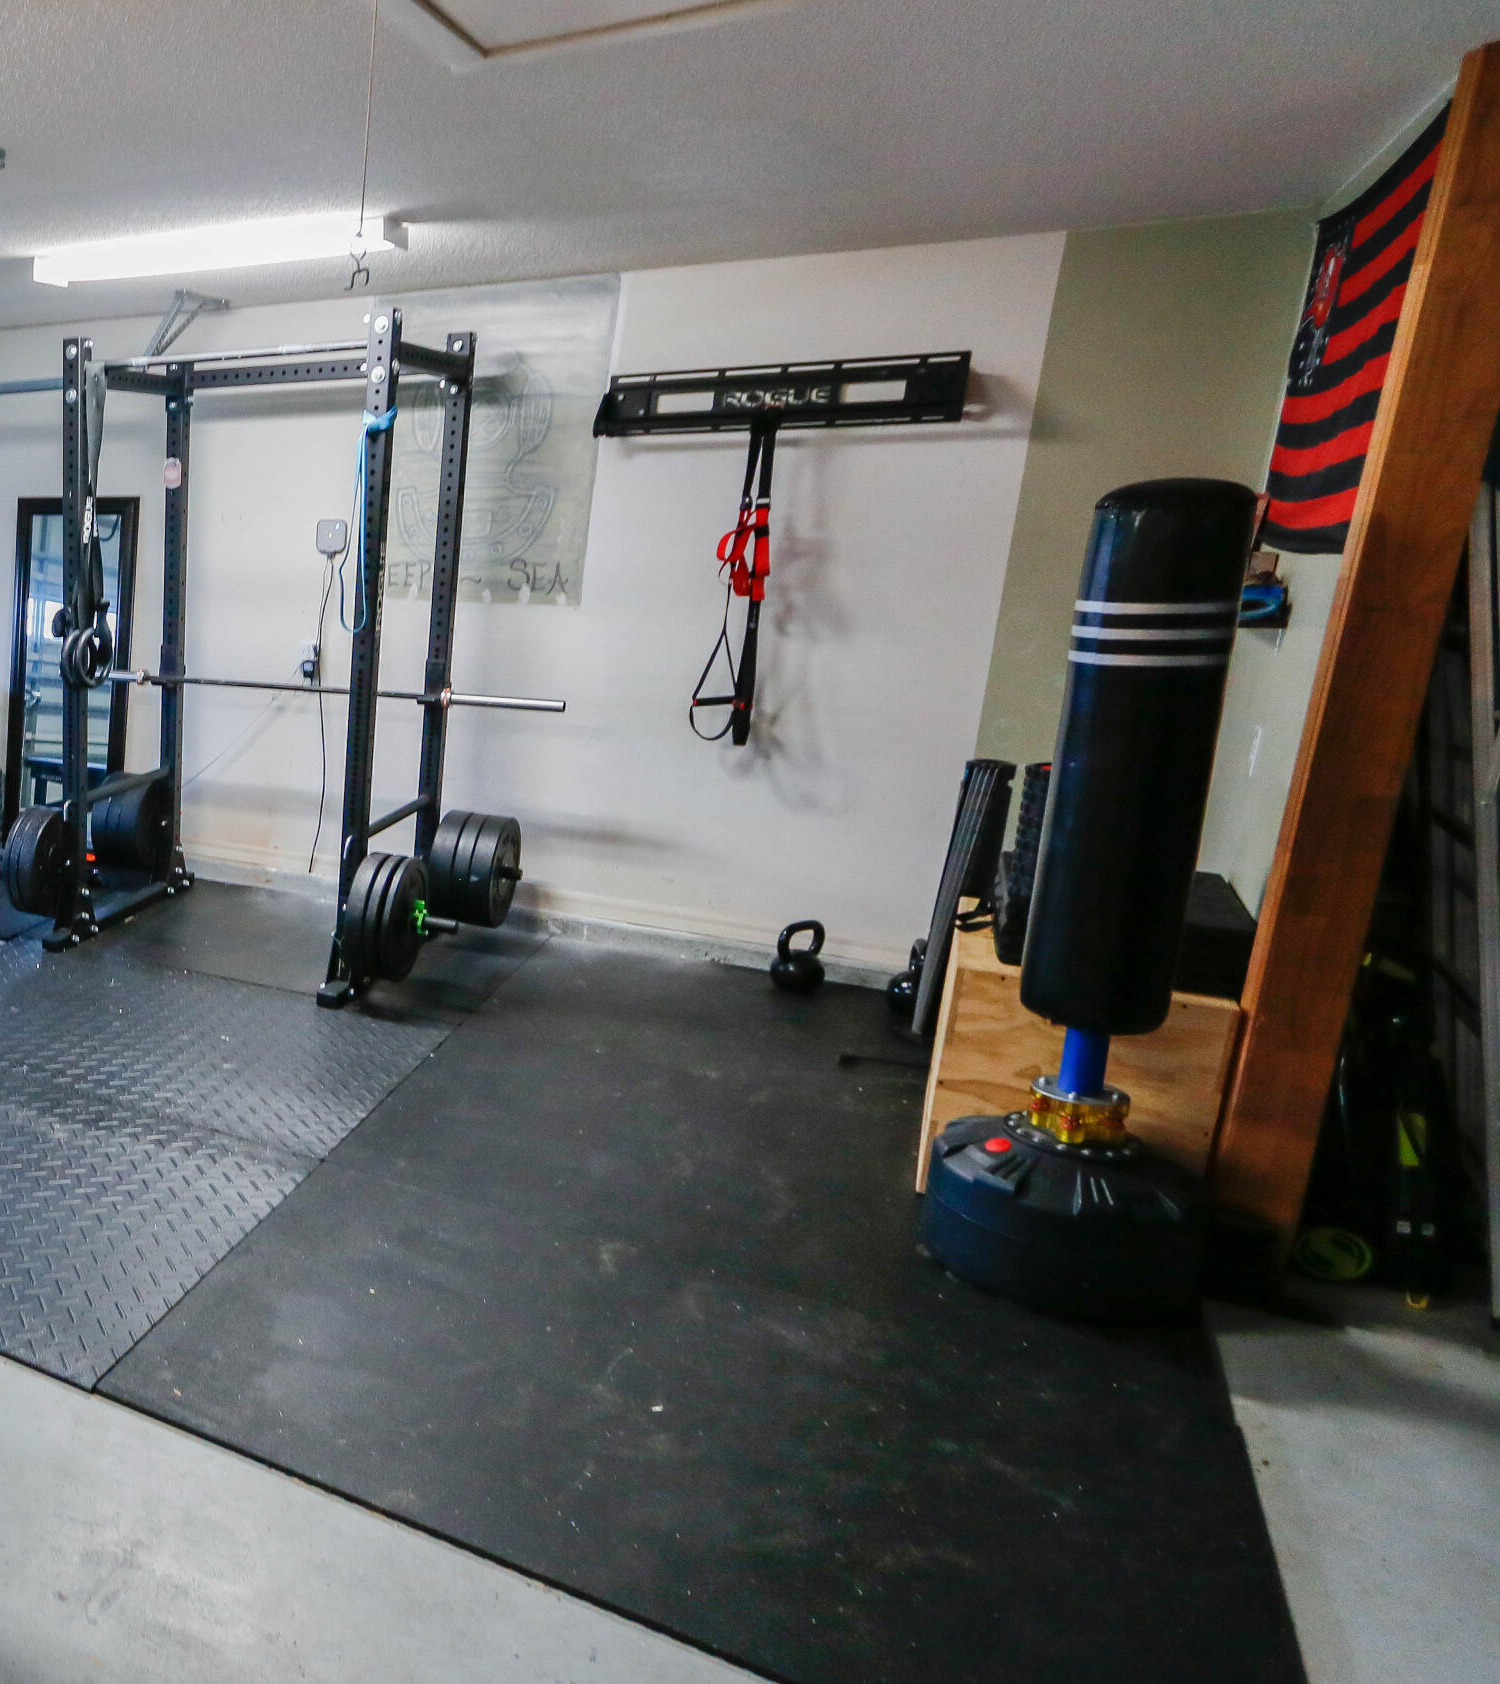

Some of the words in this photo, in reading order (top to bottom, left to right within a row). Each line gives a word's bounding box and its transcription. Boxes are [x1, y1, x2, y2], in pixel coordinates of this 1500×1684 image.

[723, 385, 831, 409] ROGUE
[82, 496, 93, 544] ROGUE
[387, 560, 432, 592] EEP
[508, 558, 569, 596] SEA
